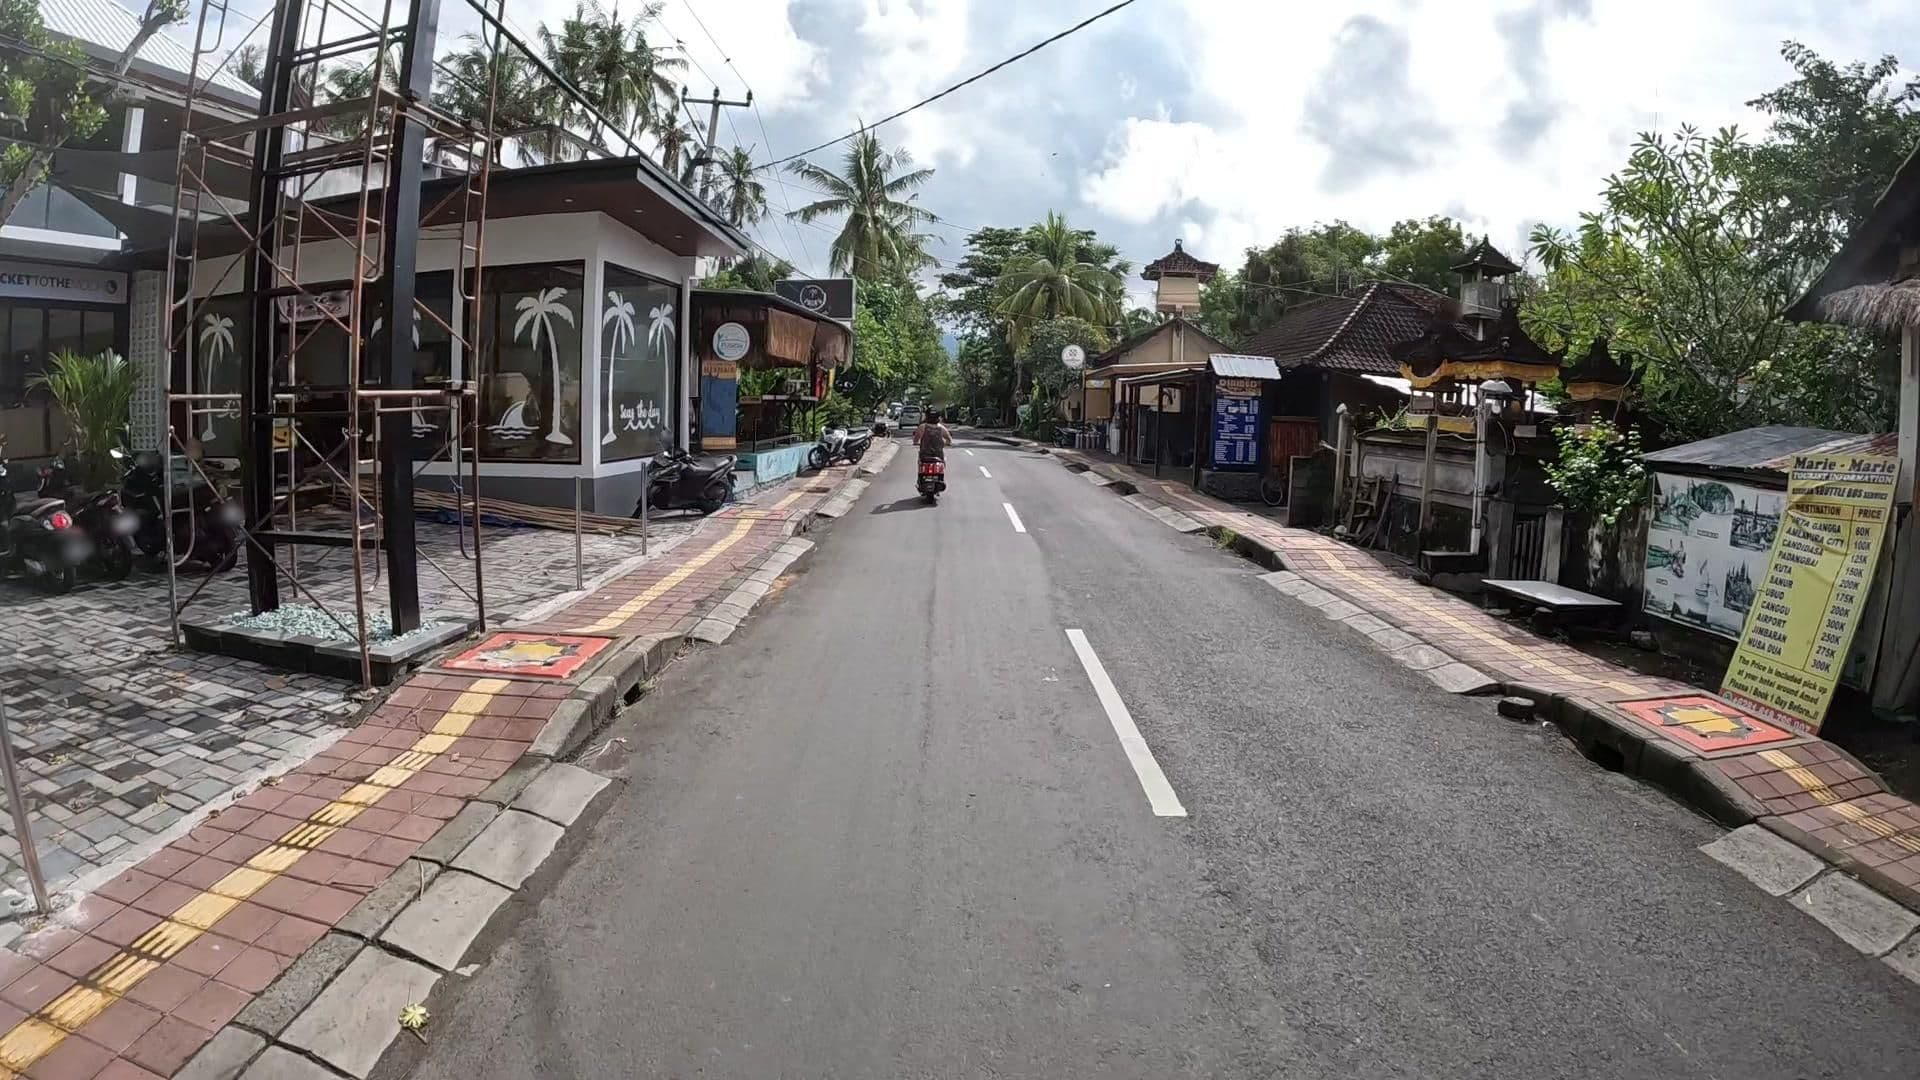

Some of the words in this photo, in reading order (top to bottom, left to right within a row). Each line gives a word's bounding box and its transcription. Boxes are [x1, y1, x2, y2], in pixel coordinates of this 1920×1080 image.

[1794, 456, 1837, 470] Marie
[1848, 459, 1896, 473] Marie
[1793, 472, 1829, 481] TOURIST
[1829, 473, 1895, 485] INFORMATION
[1858, 508, 1883, 519] PRICE
[1826, 538, 1845, 548] CITY
[1773, 563, 1793, 574] KUTA
[1769, 575, 1794, 588] SANUR
[1761, 601, 1791, 616] CANGGU
[1756, 613, 1788, 629] AIRPORT
[1752, 625, 1788, 643] JIMBARAN
[1738, 655, 1750, 666] The
[1750, 659, 1767, 672] Price
